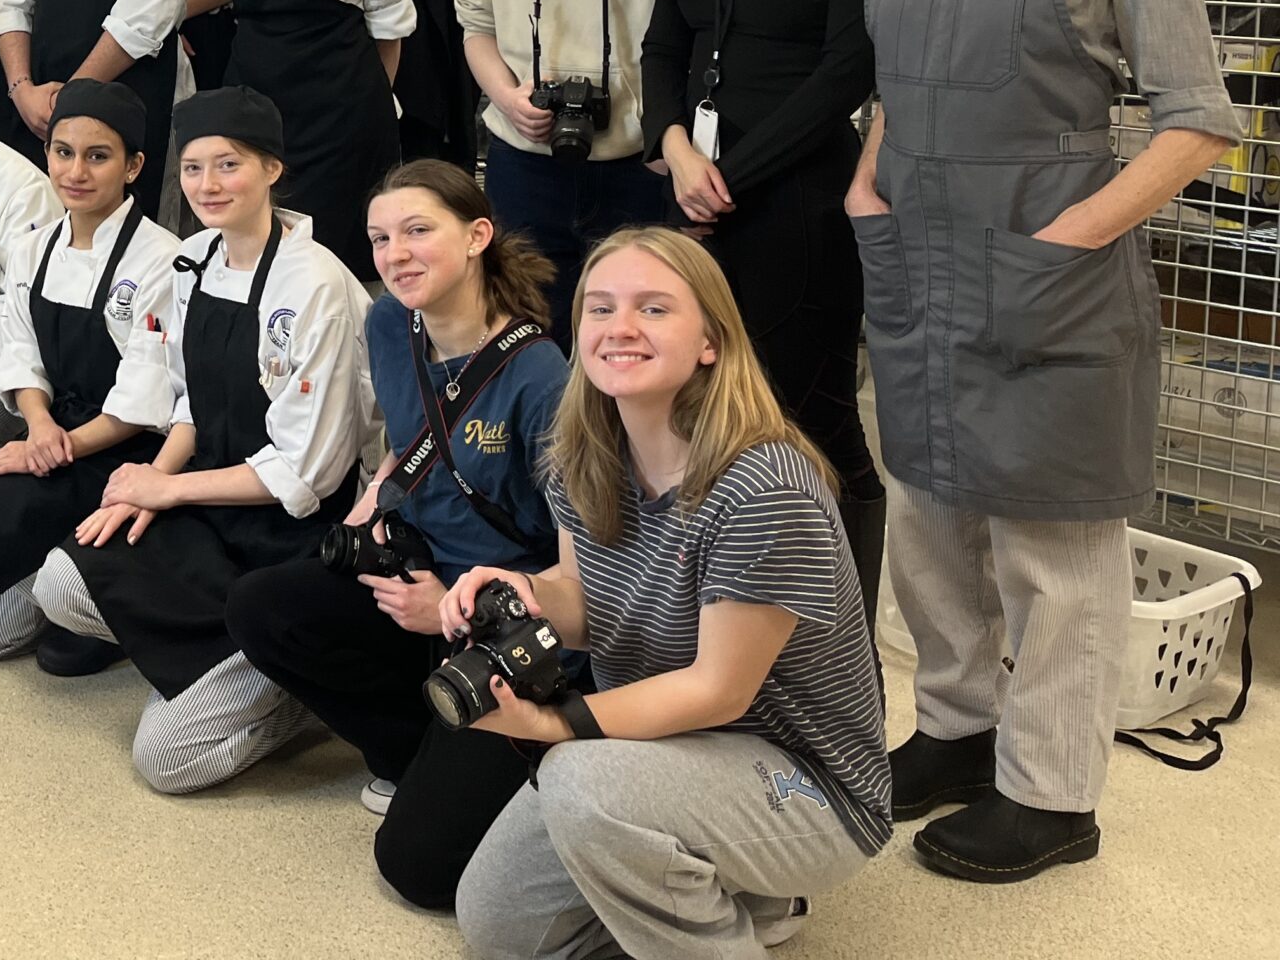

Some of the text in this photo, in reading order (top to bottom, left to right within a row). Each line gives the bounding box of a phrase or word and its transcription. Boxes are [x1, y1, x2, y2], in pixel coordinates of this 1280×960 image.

[497, 323, 543, 352] Canon
[482, 444, 507, 455] PARKS
[452, 469, 473, 495] EOS
[754, 759, 785, 814] SOFALL
[771, 767, 829, 810] K
